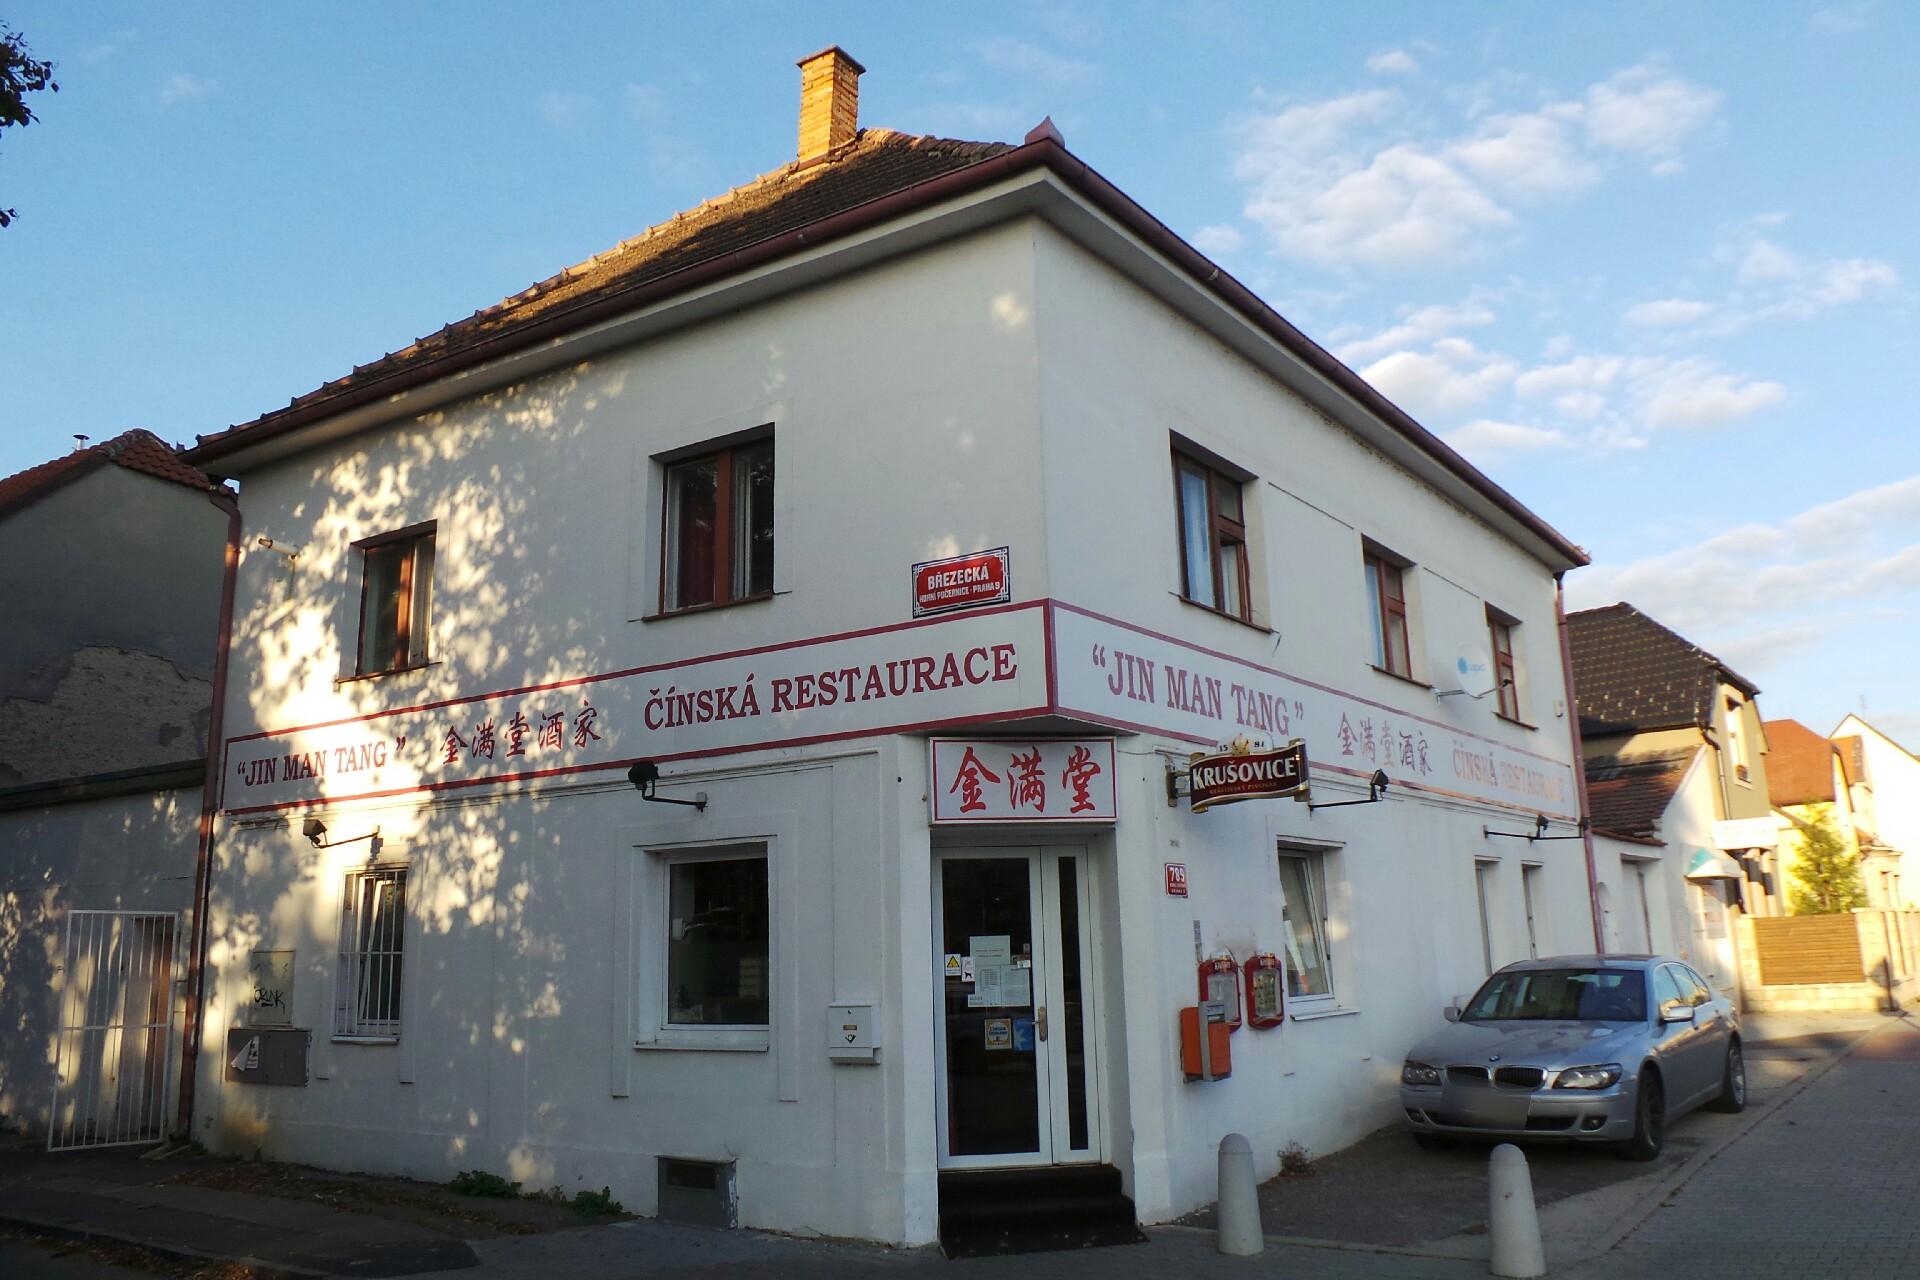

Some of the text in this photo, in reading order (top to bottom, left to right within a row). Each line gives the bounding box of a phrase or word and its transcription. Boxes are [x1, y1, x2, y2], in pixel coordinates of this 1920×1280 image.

[928, 563, 989, 590] BŘEZECKÁ
[937, 586, 969, 600] POČERNICE
[973, 583, 995, 593] PRAHA
[994, 581, 1001, 590] 9
[644, 643, 1018, 730] ČÍNSKÁ RESTAURACE
[1165, 664, 1222, 721] MAN
[439, 699, 601, 765] 金满堂酒家
[1219, 744, 1229, 753] 15
[1337, 711, 1433, 776] 金满堂酒家
[282, 750, 327, 782] MAN
[949, 745, 1101, 813] 金满堂
[1193, 757, 1297, 790] KRUŠOVICE
